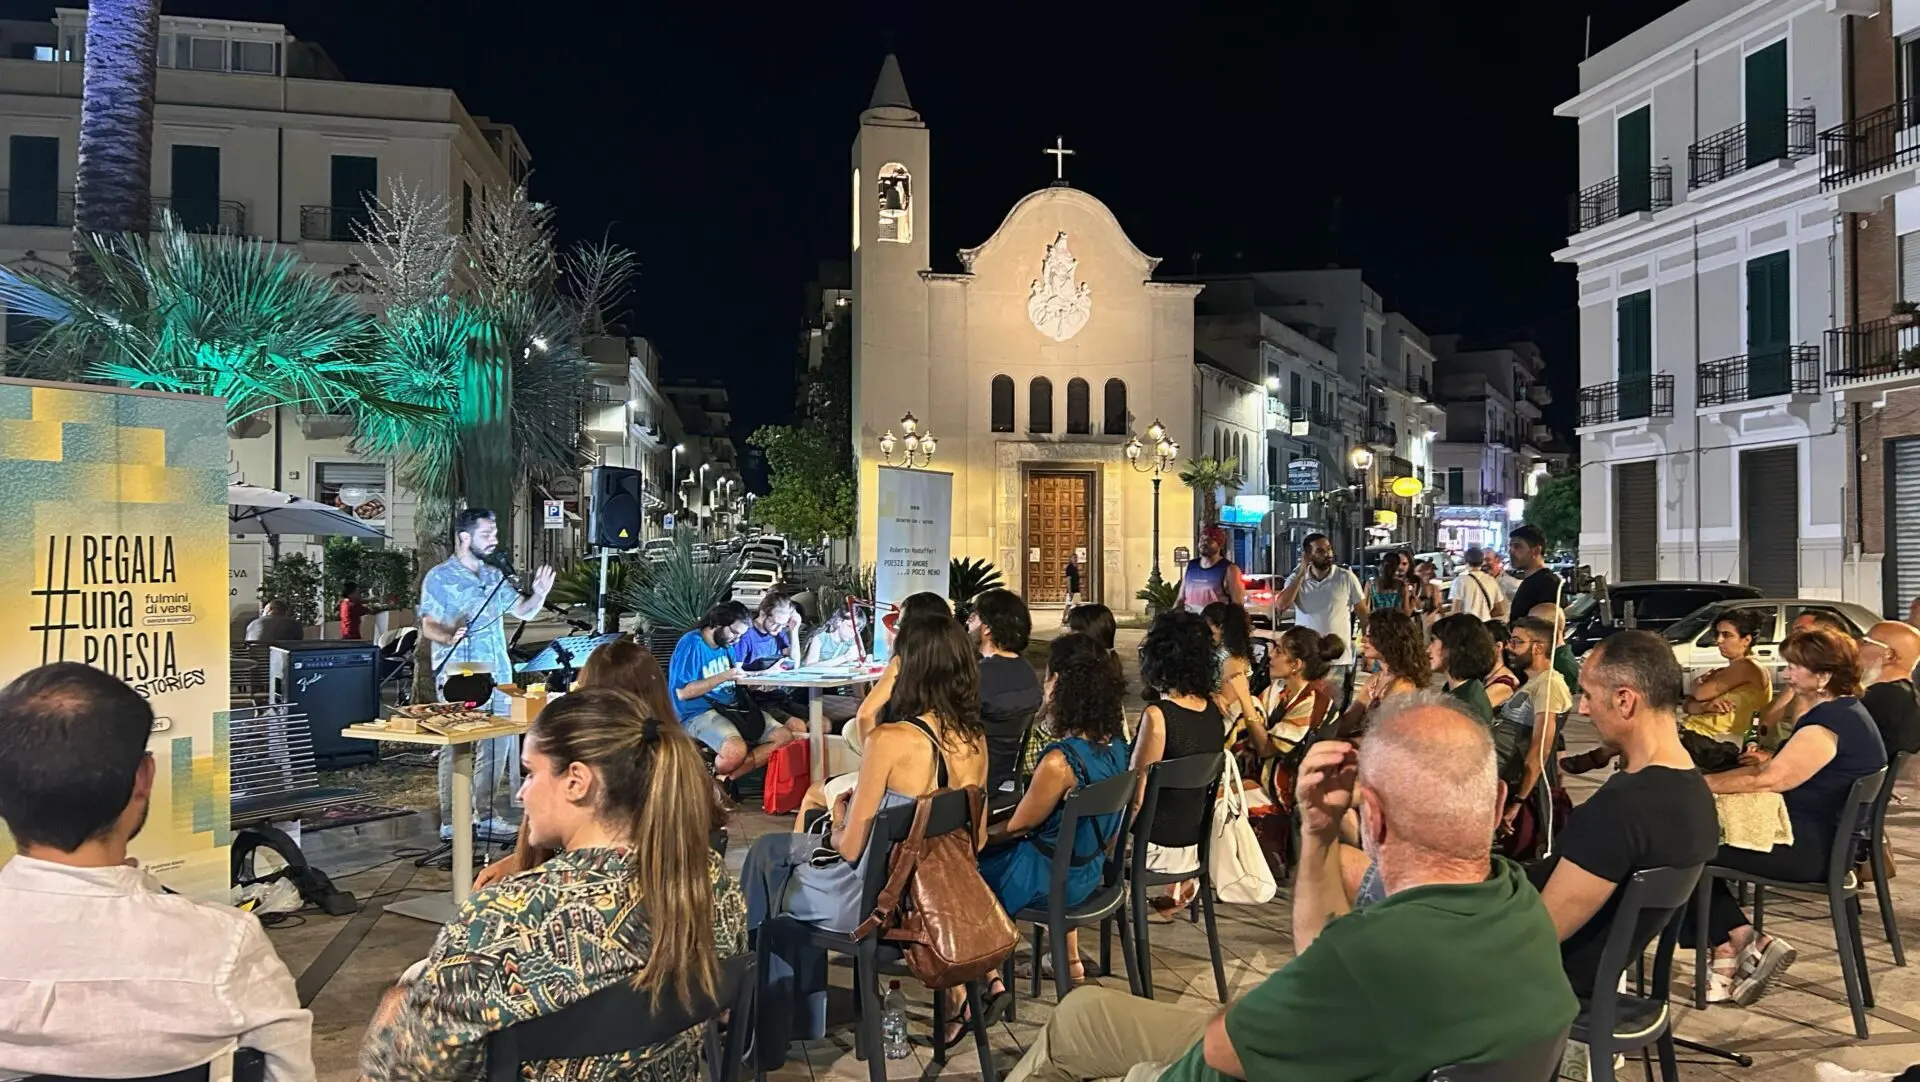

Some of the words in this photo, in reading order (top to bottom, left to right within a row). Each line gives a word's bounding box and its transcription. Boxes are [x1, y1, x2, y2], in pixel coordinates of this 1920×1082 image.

[83, 535, 177, 584] REGALA
[884, 559, 904, 567] POESIE
[82, 590, 133, 630] una
[145, 593, 189, 604] fulmini
[145, 604, 157, 614] di
[160, 603, 192, 613] versi
[84, 631, 177, 682] POESIA
